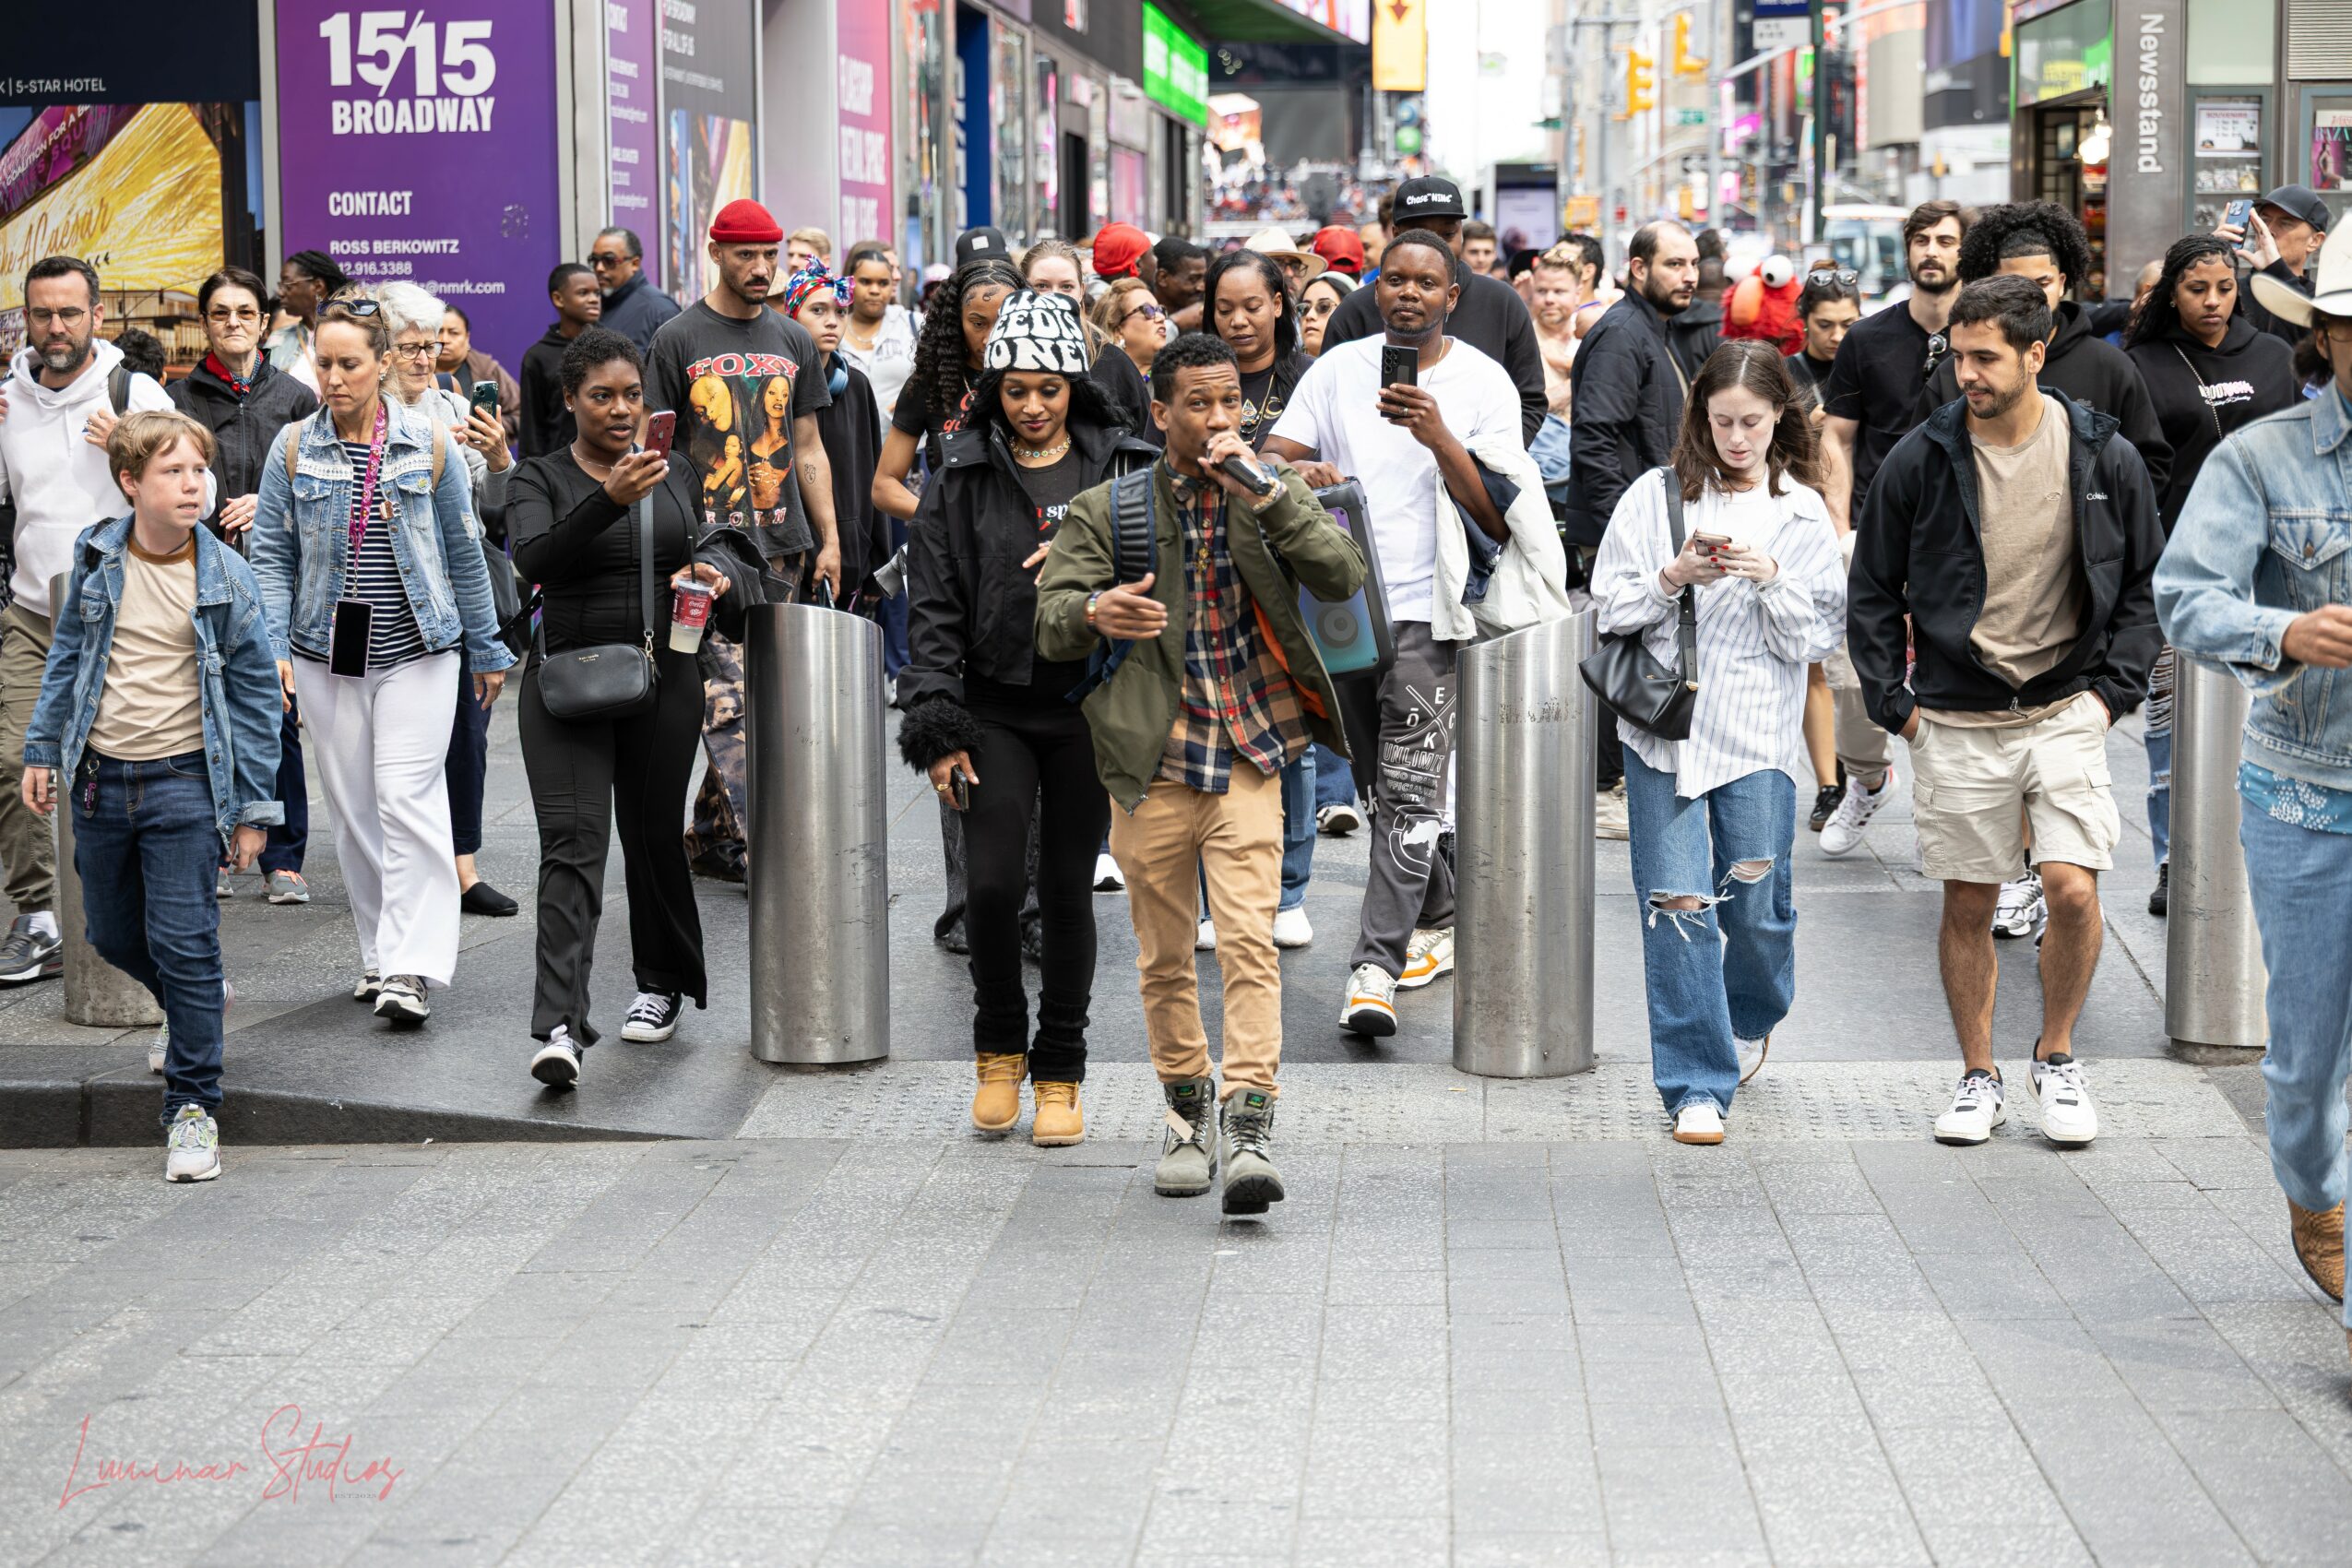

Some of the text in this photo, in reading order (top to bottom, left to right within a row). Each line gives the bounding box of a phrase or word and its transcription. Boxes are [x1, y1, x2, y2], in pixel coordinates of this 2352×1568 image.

[16, 78, 61, 94] 5-STAR
[64, 77, 107, 92] HOTEL
[2138, 13, 2165, 173] Newsstand
[331, 96, 495, 135] BROADWAY
[48, 120, 66, 146] FOR
[68, 113, 76, 128] A
[328, 191, 412, 217] CONTACT
[329, 239, 459, 255] ROSS BERKOWITZ
[338, 261, 413, 276] 12.916.3388
[686, 352, 800, 381] FOXY
